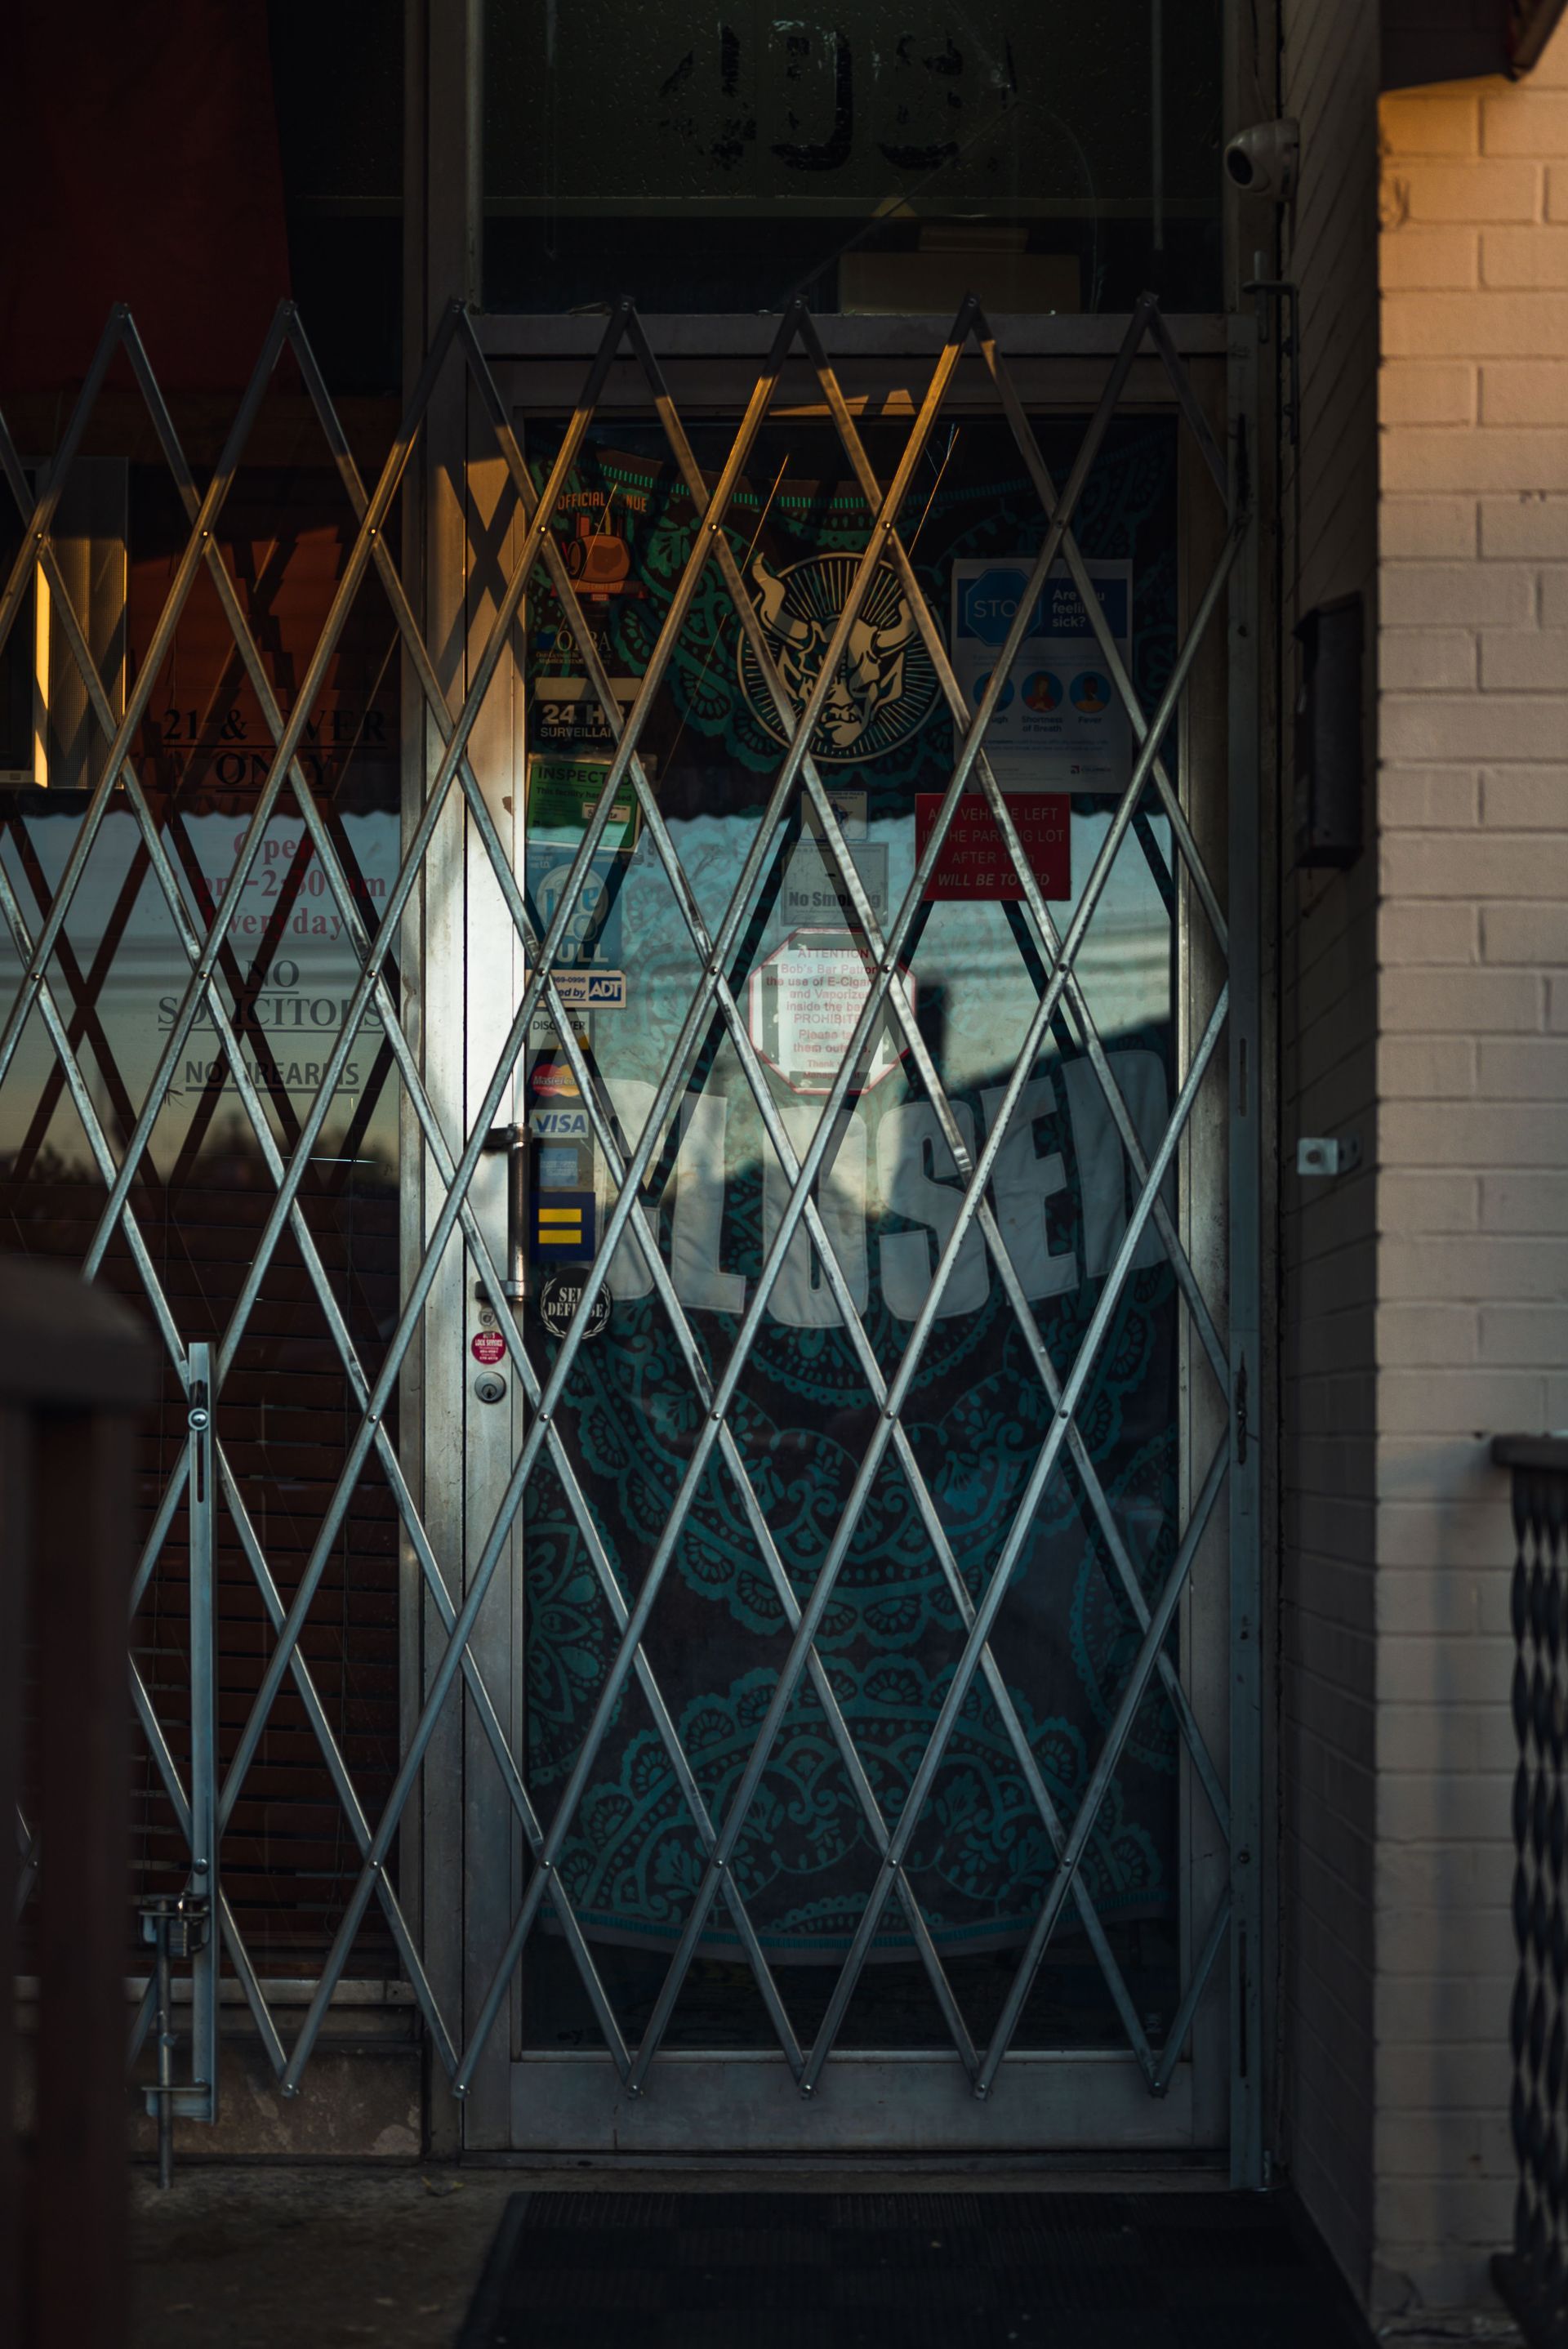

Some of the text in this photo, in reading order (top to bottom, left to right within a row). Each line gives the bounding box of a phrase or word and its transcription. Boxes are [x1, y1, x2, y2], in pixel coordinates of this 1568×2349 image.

[558, 492, 647, 513] OFFICIAL NUE
[973, 599, 1018, 618] STO
[1052, 589, 1076, 601] Are
[1052, 602, 1085, 614] feeli
[1052, 616, 1086, 627] sick?
[557, 630, 612, 651] OBA
[541, 704, 626, 724] 24 H
[1021, 715, 1063, 724] Shortness
[1078, 716, 1102, 724] Fever
[163, 709, 386, 742] 21 & VER
[540, 726, 612, 738] SURVEILLA
[1033, 724, 1062, 733] Breath
[216, 752, 332, 786] ONY
[537, 768, 632, 786] INSPECTD
[960, 807, 1059, 821] VEHIE LEFT
[948, 830, 968, 842] HE
[972, 830, 1033, 843] PARNG
[1038, 830, 1065, 842] LOT
[952, 851, 996, 863] AFTER
[938, 873, 1050, 886] WILL BE TOED
[789, 891, 881, 909] No Smog
[555, 943, 608, 962] ULL
[798, 949, 869, 959] ATTENTION
[245, 960, 300, 987] NO
[817, 964, 837, 974] Bar
[840, 964, 880, 974] Patron
[766, 976, 784, 987] the
[788, 978, 808, 987] use
[573, 987, 586, 998] by
[589, 980, 622, 997] ADT
[790, 989, 870, 1001] and Vaporize
[158, 996, 382, 1027] SICITOS
[786, 1002, 821, 1011] inside
[824, 1002, 843, 1011] the
[533, 1021, 586, 1030] DISCER
[794, 1014, 859, 1024] PROHIBIT
[826, 1043, 871, 1054] oute.
[185, 1061, 359, 1085] NO IREARS
[533, 1076, 577, 1085] MasterCa
[536, 1114, 586, 1134] VISA
[593, 1049, 1169, 1327] CLOSED
[559, 1287, 582, 1303] SE
[547, 1302, 604, 1317] DEFSE
